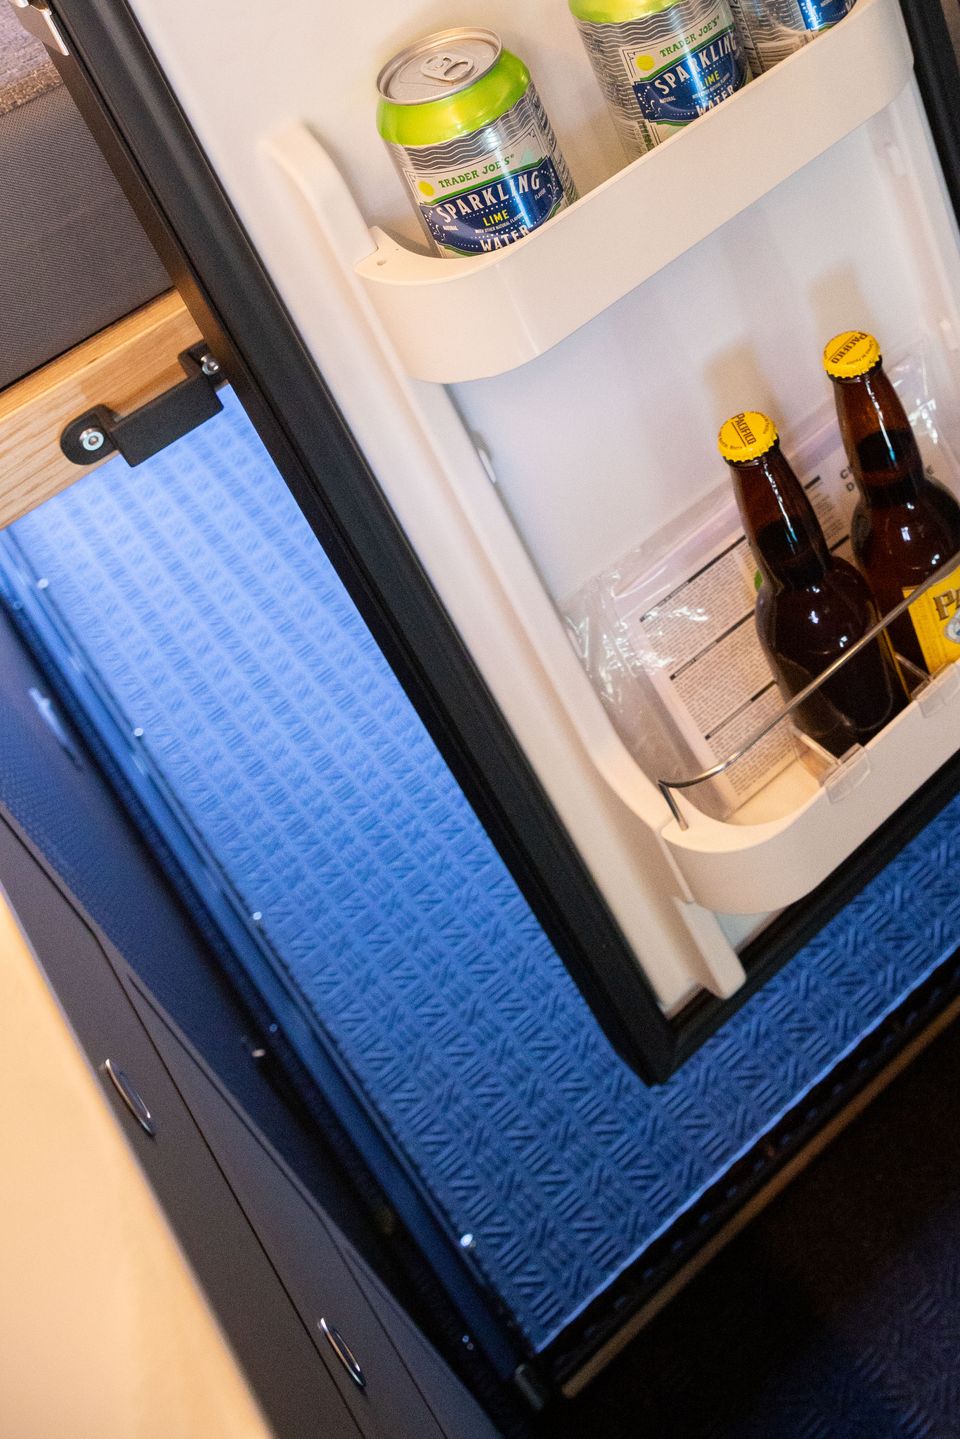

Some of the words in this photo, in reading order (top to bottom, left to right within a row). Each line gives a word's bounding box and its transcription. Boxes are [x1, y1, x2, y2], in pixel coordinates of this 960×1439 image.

[660, 33, 697, 57] TRADER
[438, 170, 479, 188] TRADER
[482, 155, 511, 174] JOES
[436, 171, 540, 223] SPARKLING
[482, 209, 509, 226] LIME
[480, 224, 530, 252] WATER
